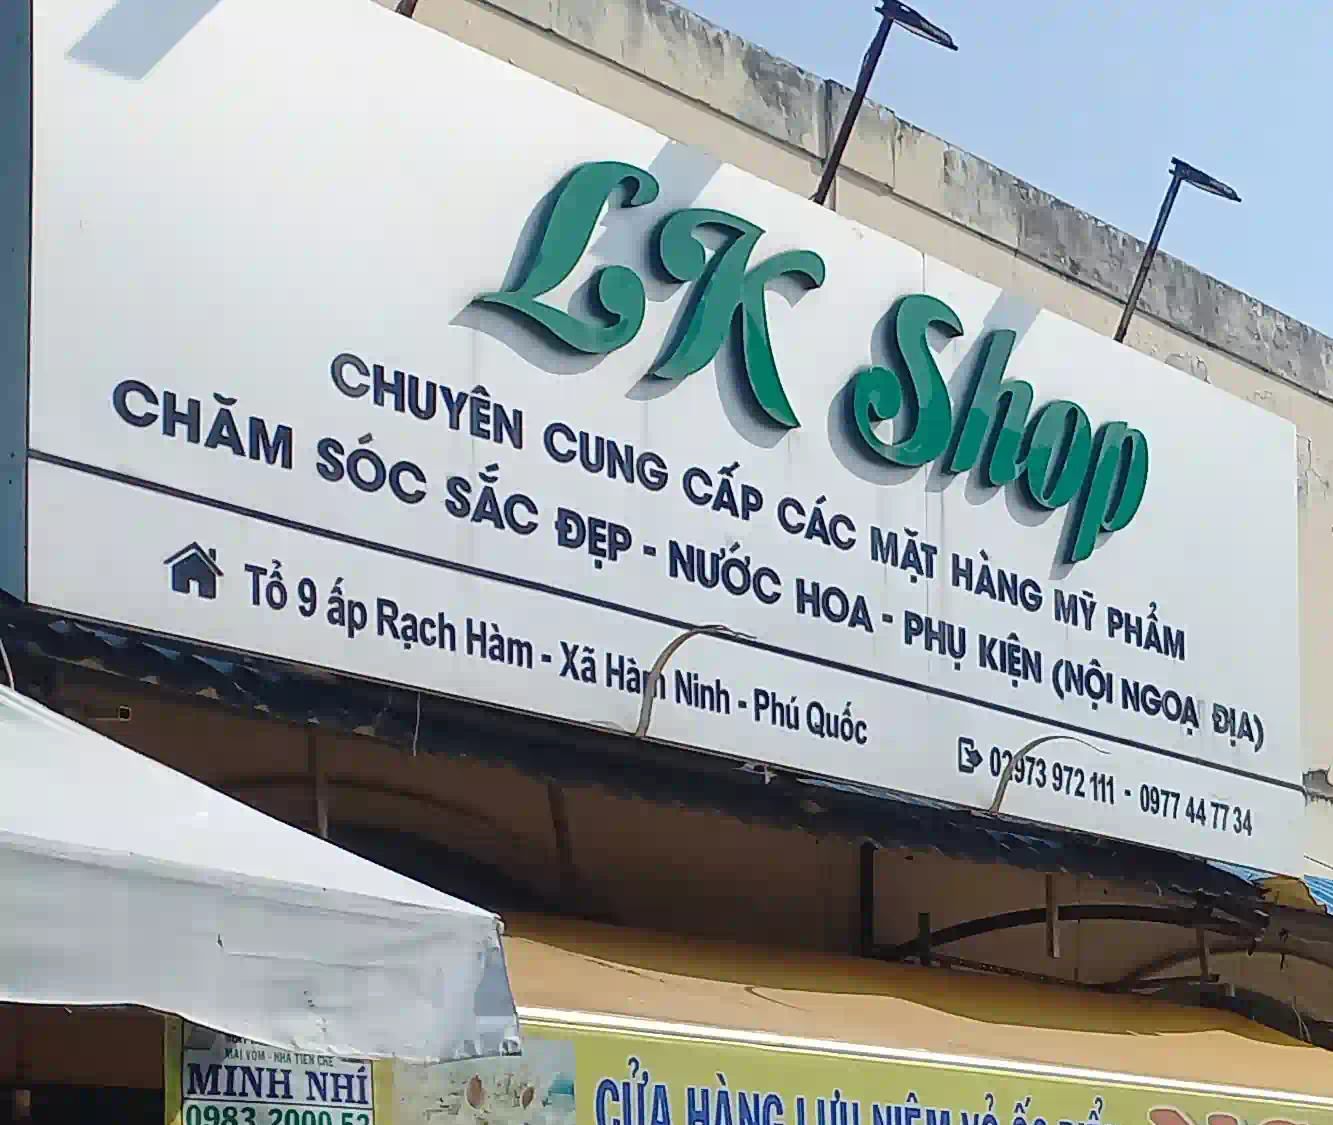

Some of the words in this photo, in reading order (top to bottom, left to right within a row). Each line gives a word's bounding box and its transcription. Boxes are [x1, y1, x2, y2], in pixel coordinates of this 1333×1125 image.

[467, 160, 826, 428] LK
[853, 293, 1149, 565] Shop
[112, 379, 294, 469] CHĂM
[316, 431, 428, 505] SÓC
[444, 463, 540, 536] SẮC
[555, 506, 633, 569] ĐẸP
[667, 540, 782, 604] NƯỚC
[795, 579, 875, 632] HOA
[903, 611, 968, 670] PHỤ
[978, 632, 1043, 688] KIỆN
[1051, 658, 1114, 711] (NỘI
[1211, 702, 1266, 754] ĐỊA)
[330, 352, 524, 449] CHUYÊN
[543, 421, 670, 492] CUNG
[682, 462, 764, 520] CẤP
[776, 496, 857, 551] CÁC
[870, 525, 938, 583] MẶT
[951, 553, 1043, 613] HÀNG
[1053, 588, 1098, 631] MỸ
[1106, 600, 1186, 660] PHẨM
[244, 558, 288, 611] Tổ
[298, 577, 318, 618] 9
[325, 576, 368, 638] ấp
[375, 598, 457, 652] Rạch
[465, 621, 534, 671] Hàm
[558, 640, 598, 684] Xã
[673, 668, 732, 716] Ninh
[752, 686, 801, 732] Phú
[805, 699, 869, 746] Quốc
[1052, 760, 1087, 799] 972
[1088, 770, 1116, 806] 111
[1138, 782, 1182, 820] 0977
[1183, 795, 1208, 829] 44
[1209, 800, 1232, 833] 77
[1231, 804, 1254, 838] 34
[187, 1062, 294, 1099] MINH
[304, 1065, 370, 1105] NHÍ
